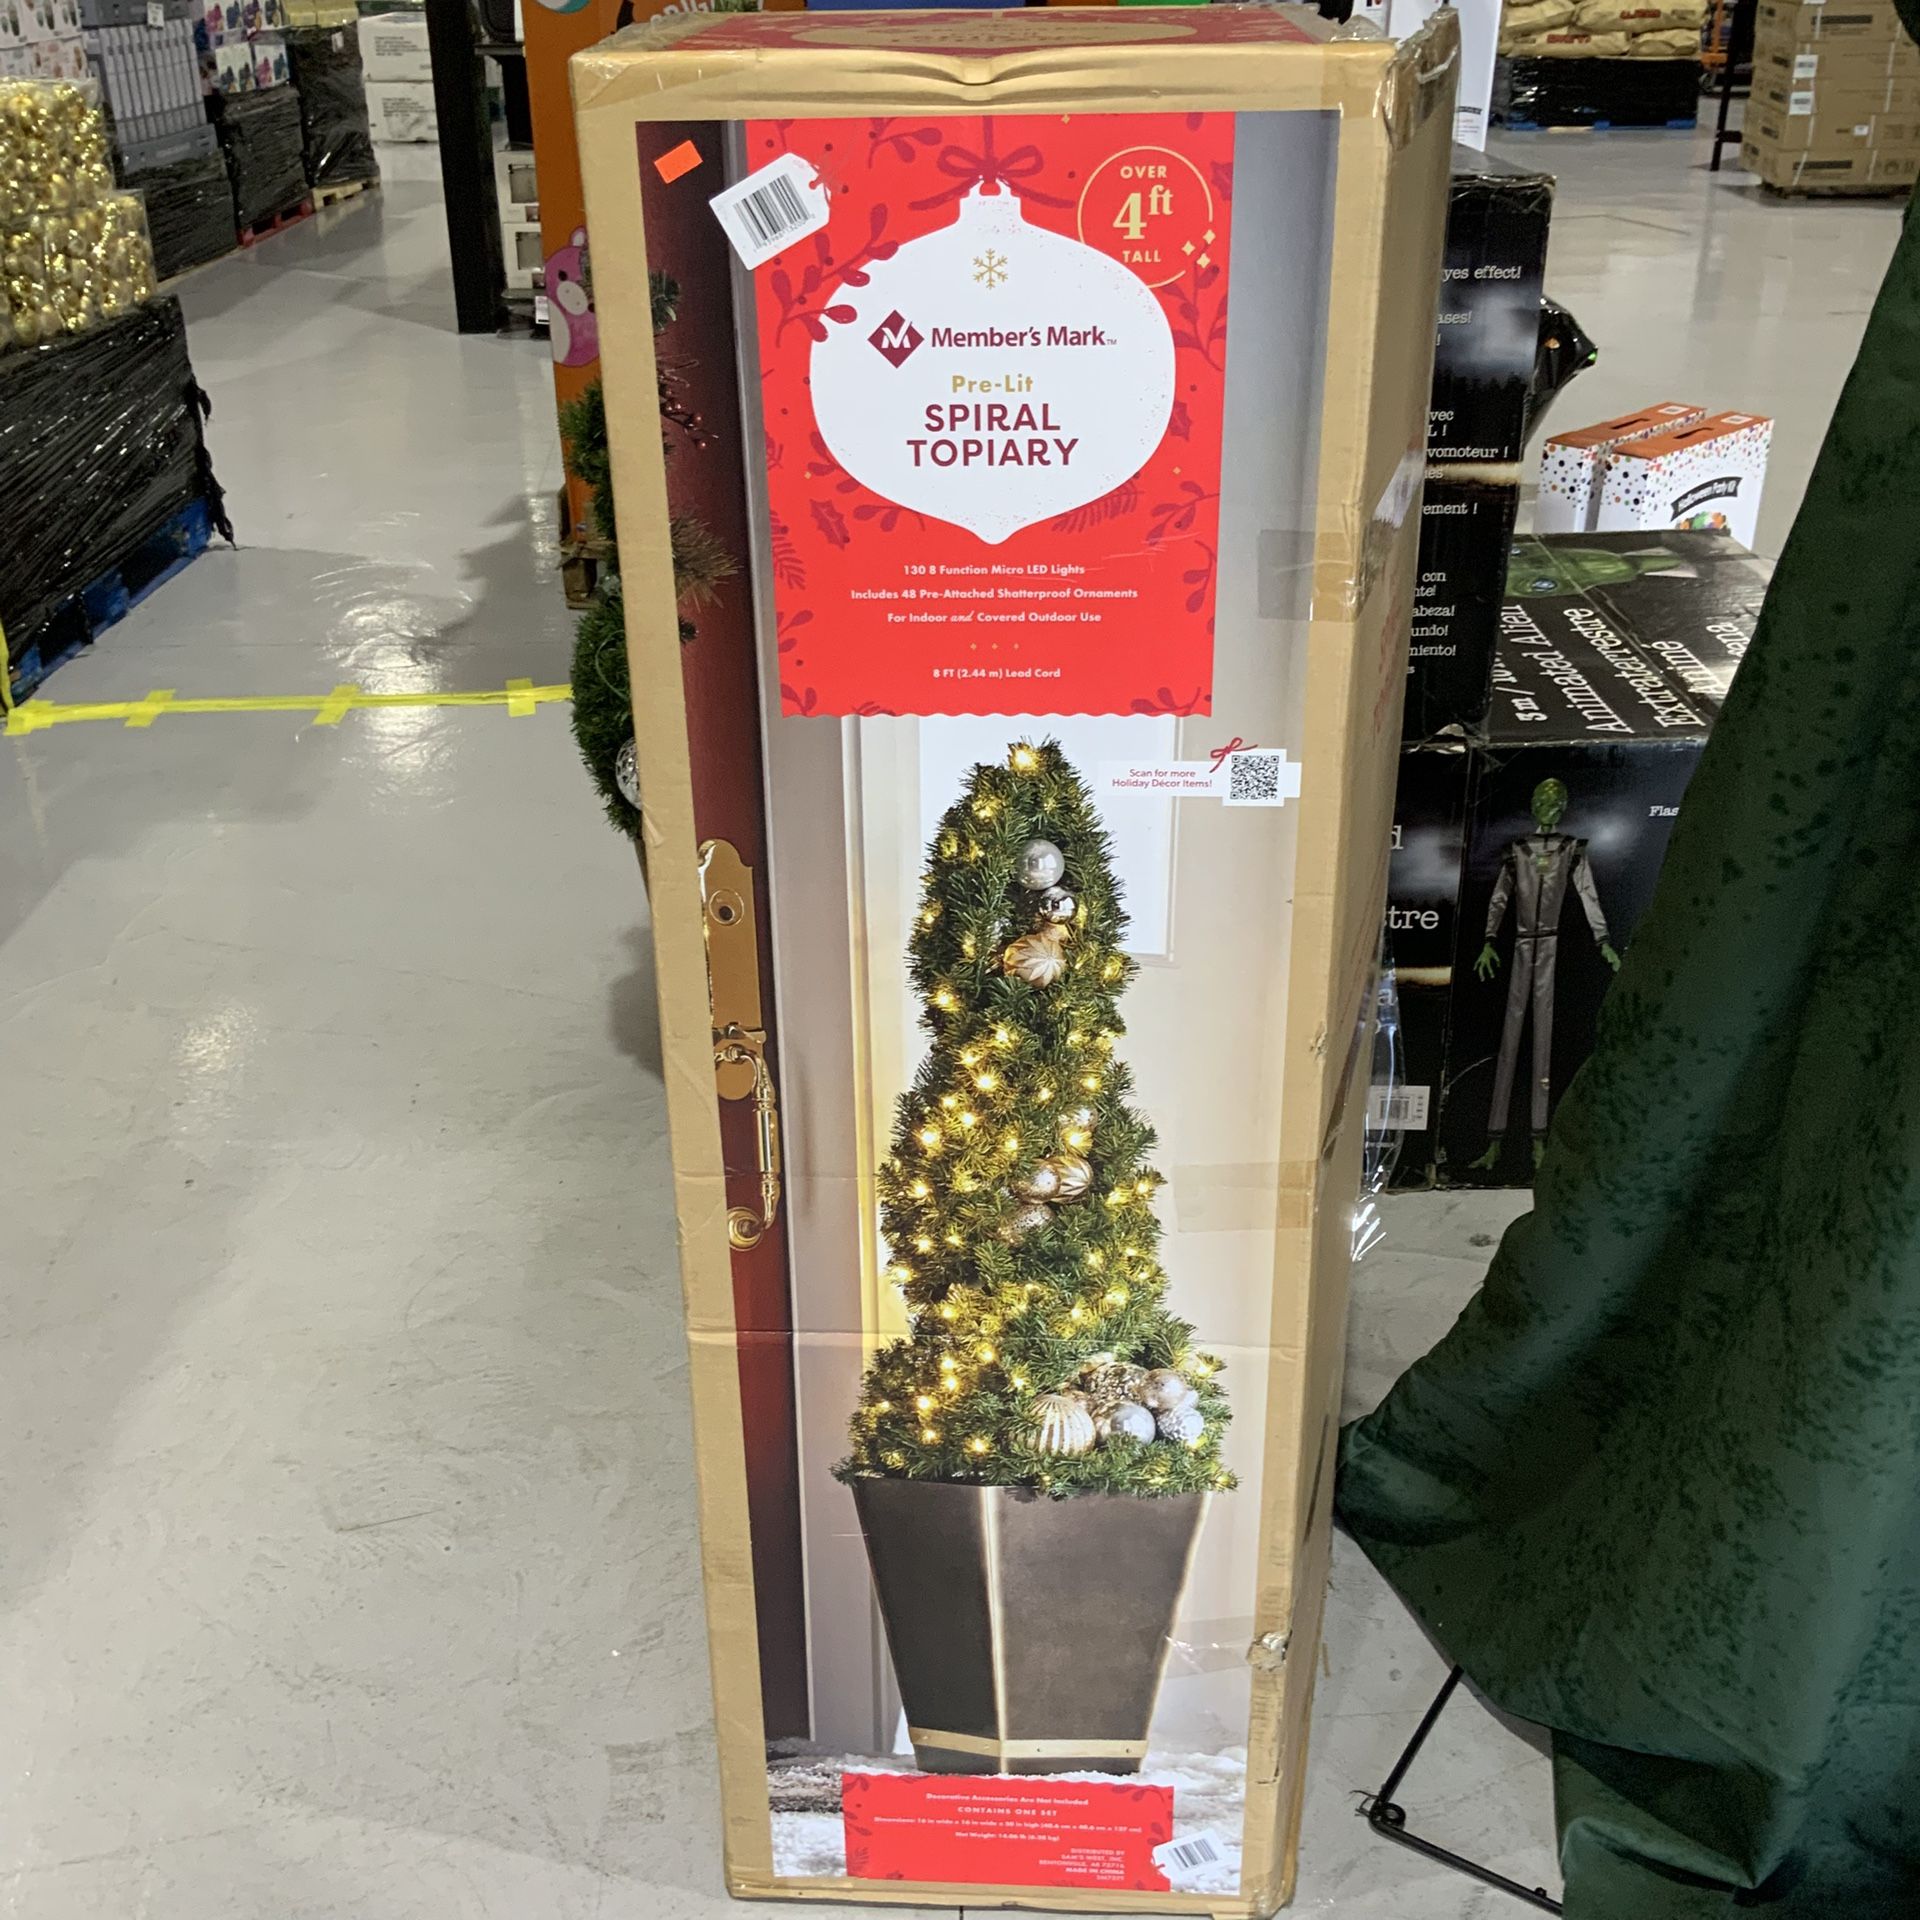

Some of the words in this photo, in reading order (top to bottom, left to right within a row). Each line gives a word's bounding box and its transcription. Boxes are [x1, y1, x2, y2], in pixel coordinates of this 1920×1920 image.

[1120, 165, 1167, 179] OVER
[1122, 250, 1162, 263] TALL
[1474, 265, 1522, 279] effect!
[932, 326, 1041, 348] Member's
[1046, 325, 1106, 347] Mark
[952, 373, 1034, 393] Pre-Lit
[924, 402, 1061, 432] SPIRAL
[906, 438, 1079, 467] TOPIARY
[1422, 502, 1468, 514] ement
[904, 565, 926, 575] 130
[940, 564, 988, 575] Function
[991, 564, 1024, 574] Micro
[1027, 564, 1048, 574] LED
[1051, 564, 1085, 577] Lights
[1422, 572, 1446, 582] con
[851, 589, 899, 600] Includes
[902, 589, 916, 599] 48
[920, 588, 994, 599] Pre-Attached
[998, 588, 1071, 600] Shatterproof
[1074, 588, 1138, 598] Ornaments
[888, 613, 906, 622] For
[909, 612, 948, 622] Indoor
[950, 610, 974, 622] and
[977, 612, 1025, 622] Covered
[1028, 612, 1077, 622] Outdoor
[1080, 612, 1102, 622] Use
[933, 668, 940, 678] 8
[943, 668, 954, 678] FT
[957, 668, 986, 679] (2.44
[989, 668, 1003, 680] m)
[1006, 668, 1032, 678] Lead
[1034, 668, 1061, 678] Cord
[1563, 608, 1706, 728] Extraterrestre
[1520, 650, 1635, 734] Animated
[1129, 769, 1153, 778] Scan
[1154, 769, 1168, 778] for
[1112, 779, 1150, 788] Holiday
[1182, 779, 1212, 788] Items!
[1387, 905, 1440, 930] tre
[958, 1807, 1011, 1816] CONTAINS
[1015, 1808, 1036, 1816] ONE
